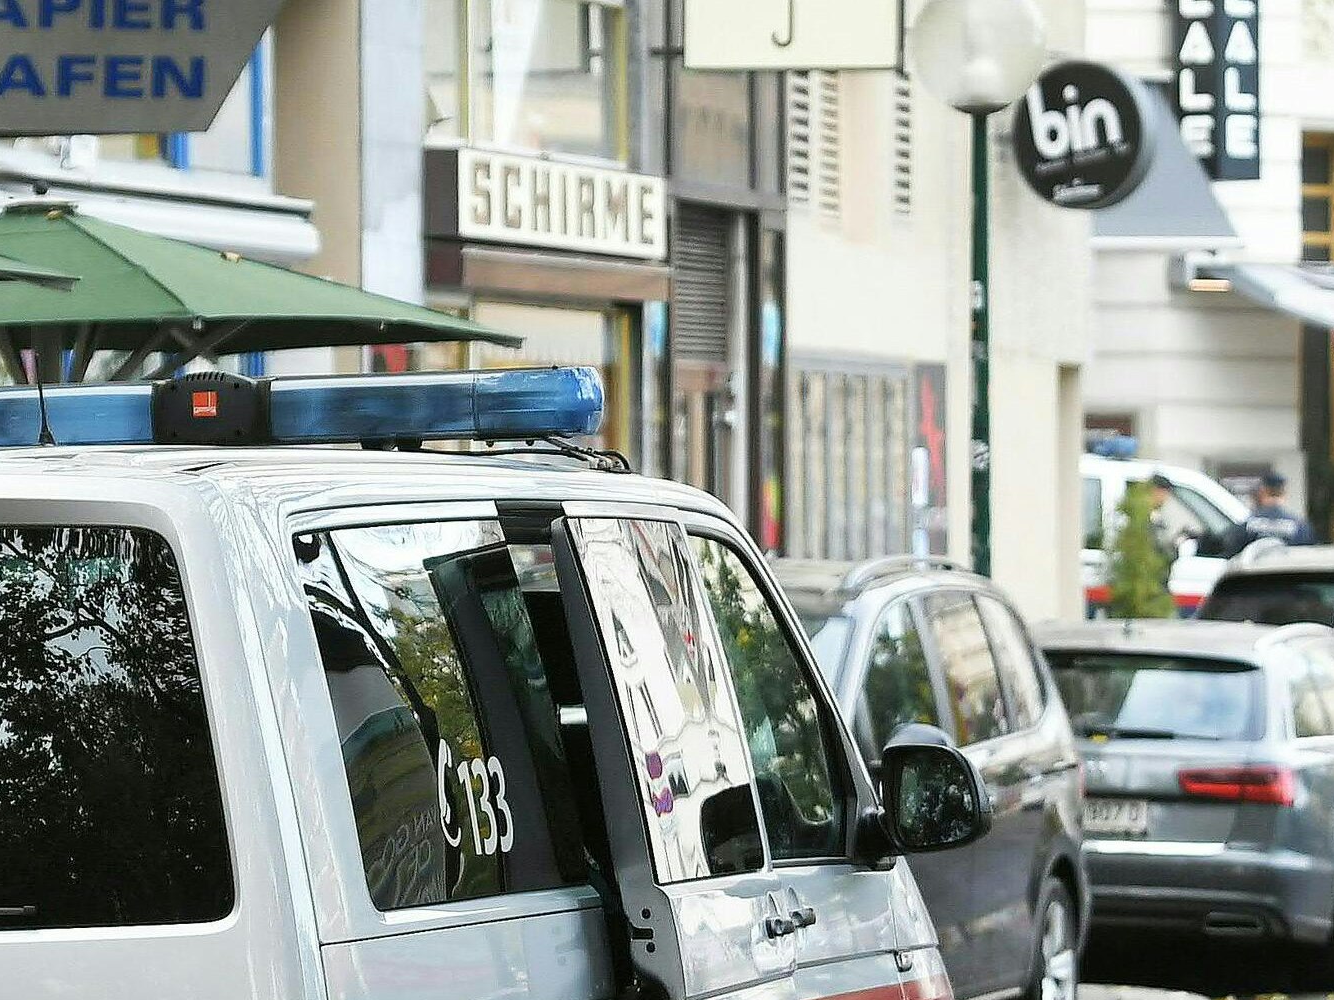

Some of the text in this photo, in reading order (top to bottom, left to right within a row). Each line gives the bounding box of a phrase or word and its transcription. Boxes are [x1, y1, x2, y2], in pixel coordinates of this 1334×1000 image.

[1026, 82, 1123, 160] bin
[473, 161, 654, 245] SCHIRME
[457, 756, 514, 856] 133
